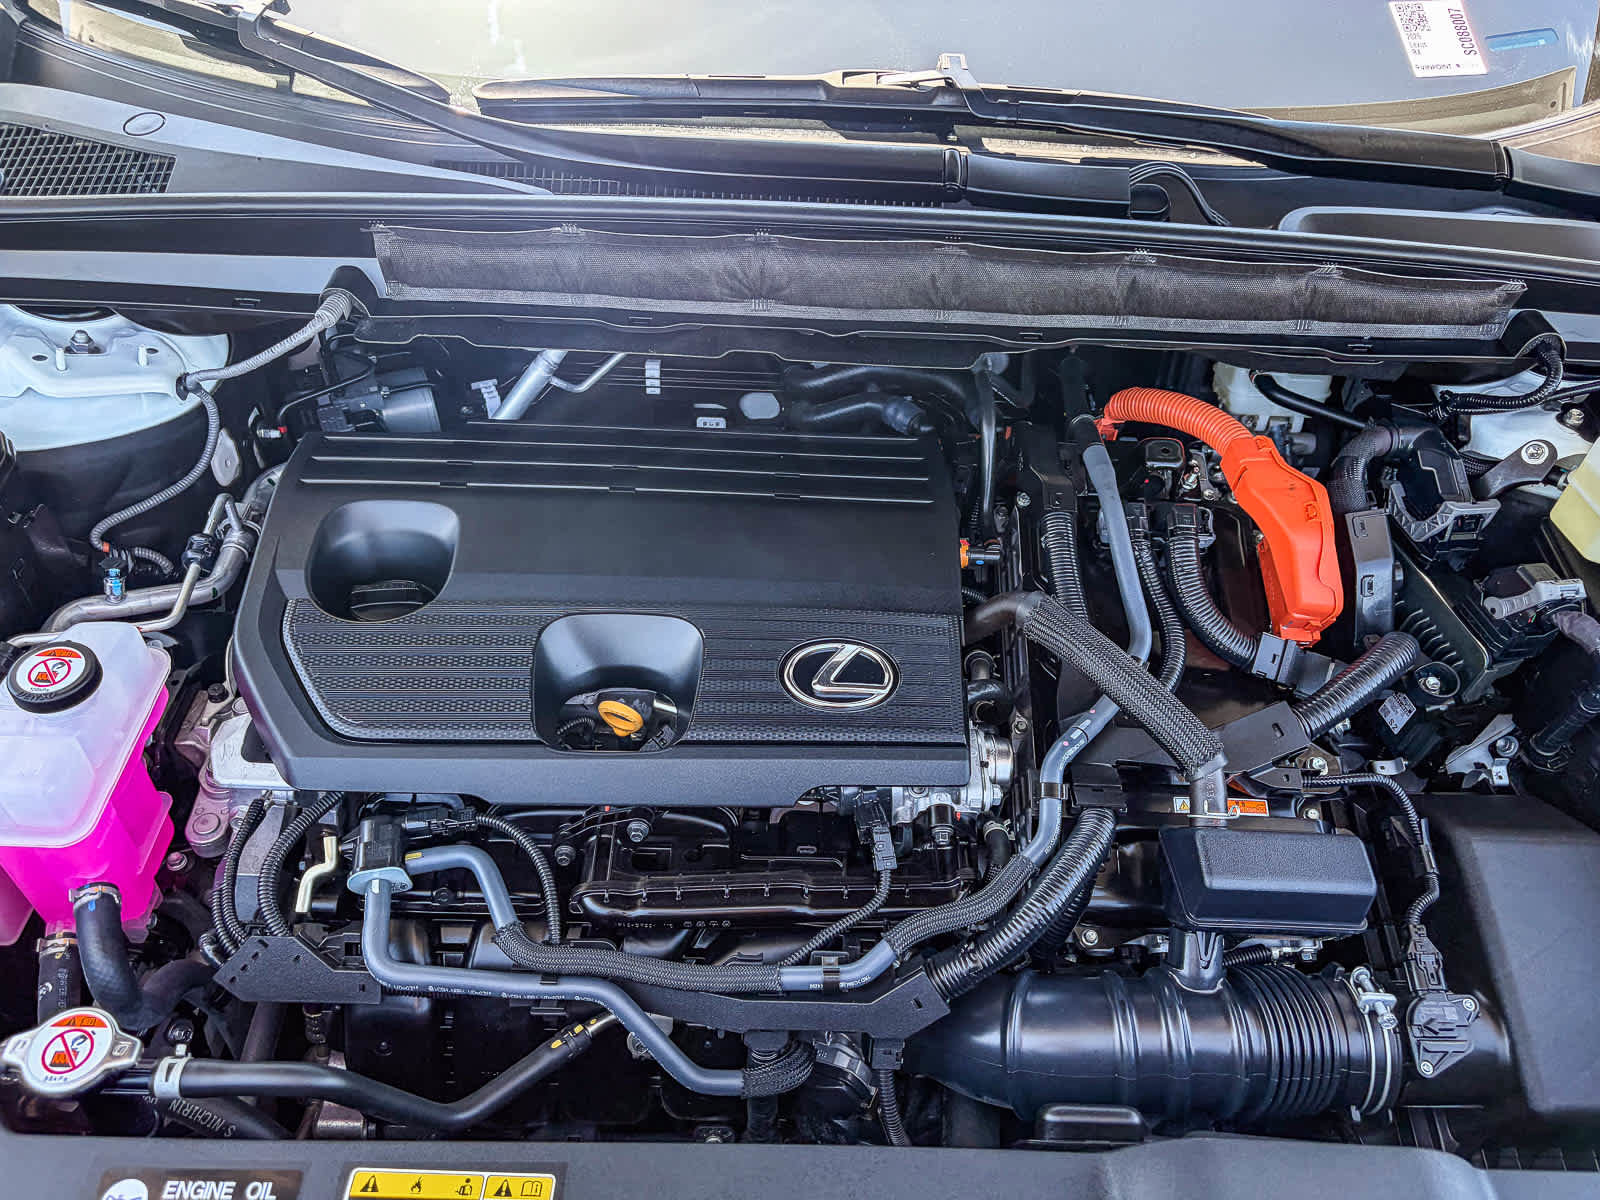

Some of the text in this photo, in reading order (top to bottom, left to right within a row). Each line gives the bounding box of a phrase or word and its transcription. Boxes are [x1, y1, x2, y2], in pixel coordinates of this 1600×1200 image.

[1448, 8, 1477, 55] SC088007
[162, 1180, 277, 1200] ENGINE OIL
